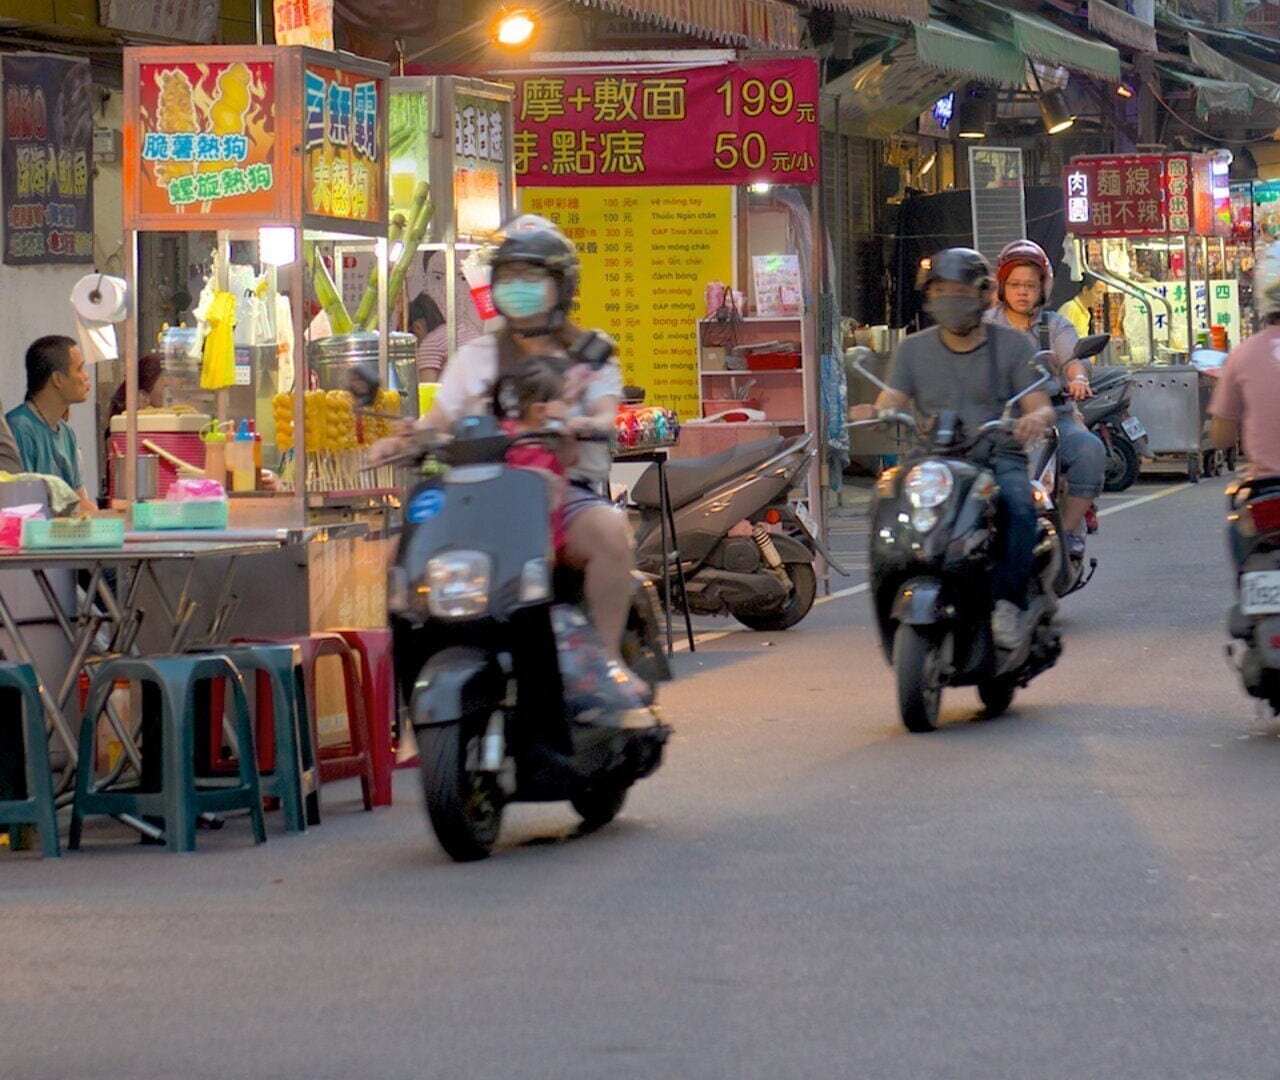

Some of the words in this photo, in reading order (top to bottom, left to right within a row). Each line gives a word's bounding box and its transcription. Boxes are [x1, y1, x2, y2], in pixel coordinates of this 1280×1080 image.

[143, 132, 248, 161] 脆薯熱狗
[169, 163, 272, 205] 螺旋熱狗
[1096, 167, 1151, 197] 麵線
[688, 197, 703, 207] tay
[603, 212, 619, 222] 100
[623, 212, 633, 223] 元
[1092, 199, 1159, 227] 甜不辣
[605, 228, 620, 238] 300
[624, 228, 634, 238] 元
[604, 243, 619, 253] 300
[624, 243, 634, 253] 元
[624, 258, 634, 268] 元
[605, 273, 620, 283] 150
[624, 273, 634, 283] 元
[611, 288, 620, 297] 50
[625, 288, 635, 298] 元
[605, 303, 620, 312] 999
[610, 318, 620, 327] 50
[670, 393, 682, 401] tay
